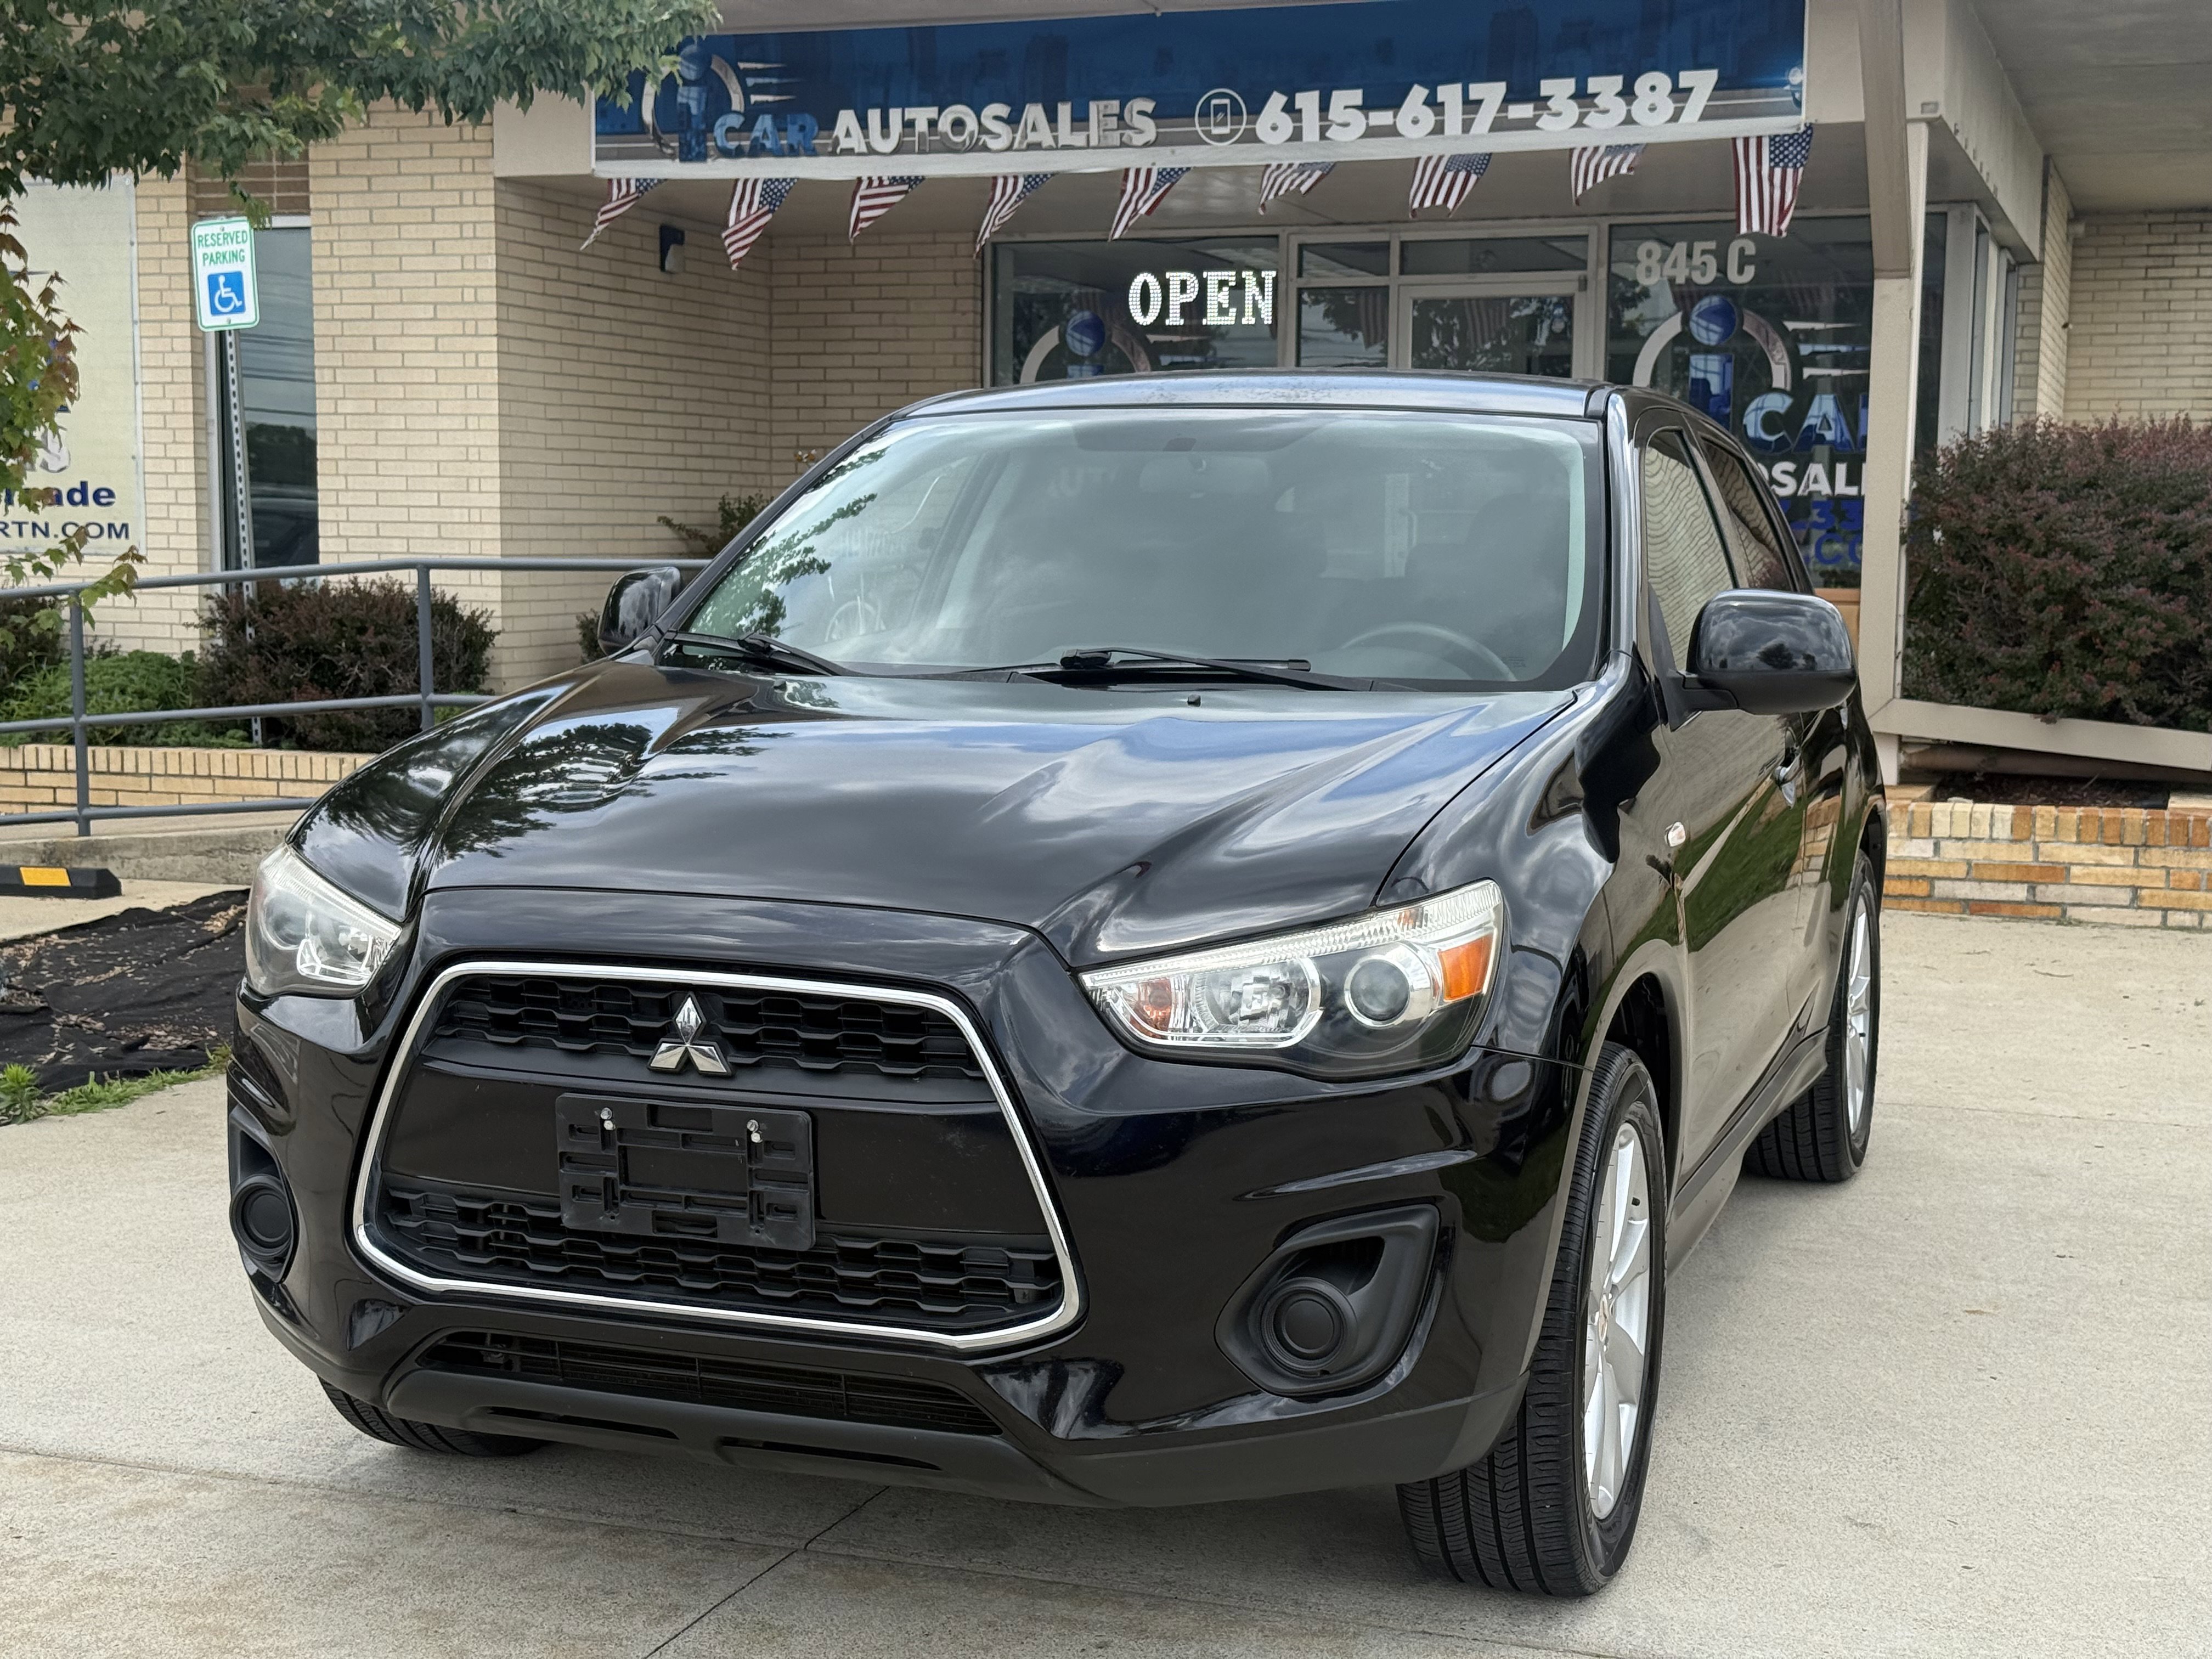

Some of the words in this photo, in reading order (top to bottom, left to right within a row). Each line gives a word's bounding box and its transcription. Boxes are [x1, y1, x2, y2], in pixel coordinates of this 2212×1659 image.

[827, 98, 1158, 155] AUTOSALES
[1255, 69, 1719, 145] 615-617-3387
[197, 230, 249, 249] RESERVED
[202, 249, 246, 267] PARKING
[1635, 240, 1718, 286] 845
[1726, 238, 1756, 285] C
[1128, 270, 1277, 326] OPEN
[1757, 461, 1866, 497] SAL
